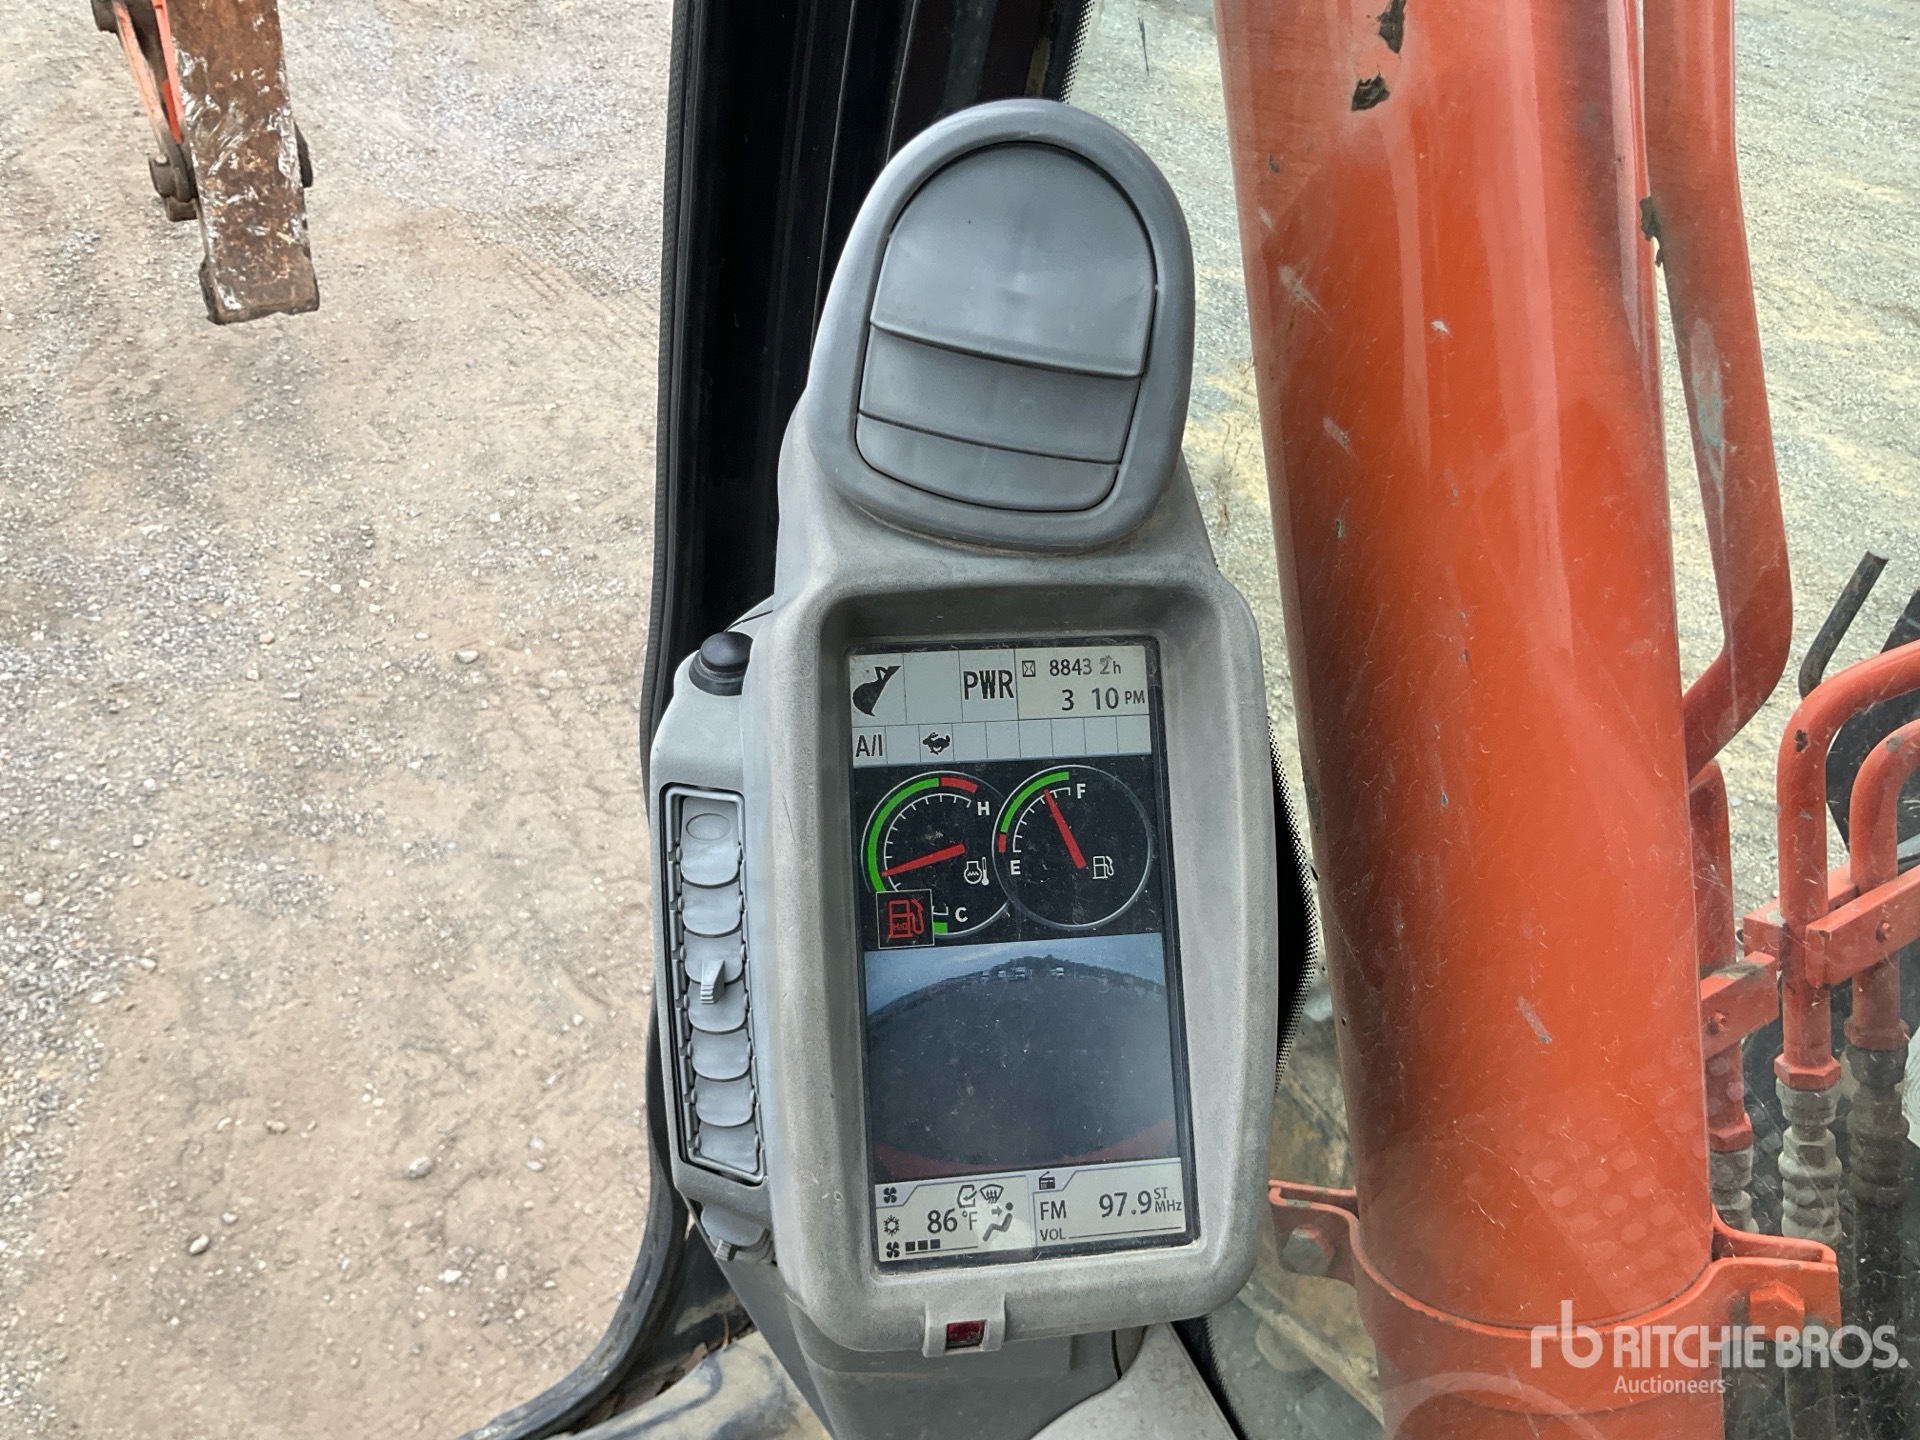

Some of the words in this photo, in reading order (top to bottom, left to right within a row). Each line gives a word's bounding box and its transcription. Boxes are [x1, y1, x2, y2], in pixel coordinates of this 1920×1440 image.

[963, 669, 1015, 701] PWR
[1124, 690, 1146, 704] PM
[1076, 784, 1087, 799] F
[977, 801, 991, 816] H
[1010, 860, 1021, 875] E
[955, 906, 968, 922] C
[1153, 1186, 1168, 1200] ST
[1040, 1200, 1067, 1221] FM
[1099, 1189, 1152, 1218] 97.9
[1154, 1199, 1182, 1213] MHz
[1040, 1228, 1067, 1242] VOL
